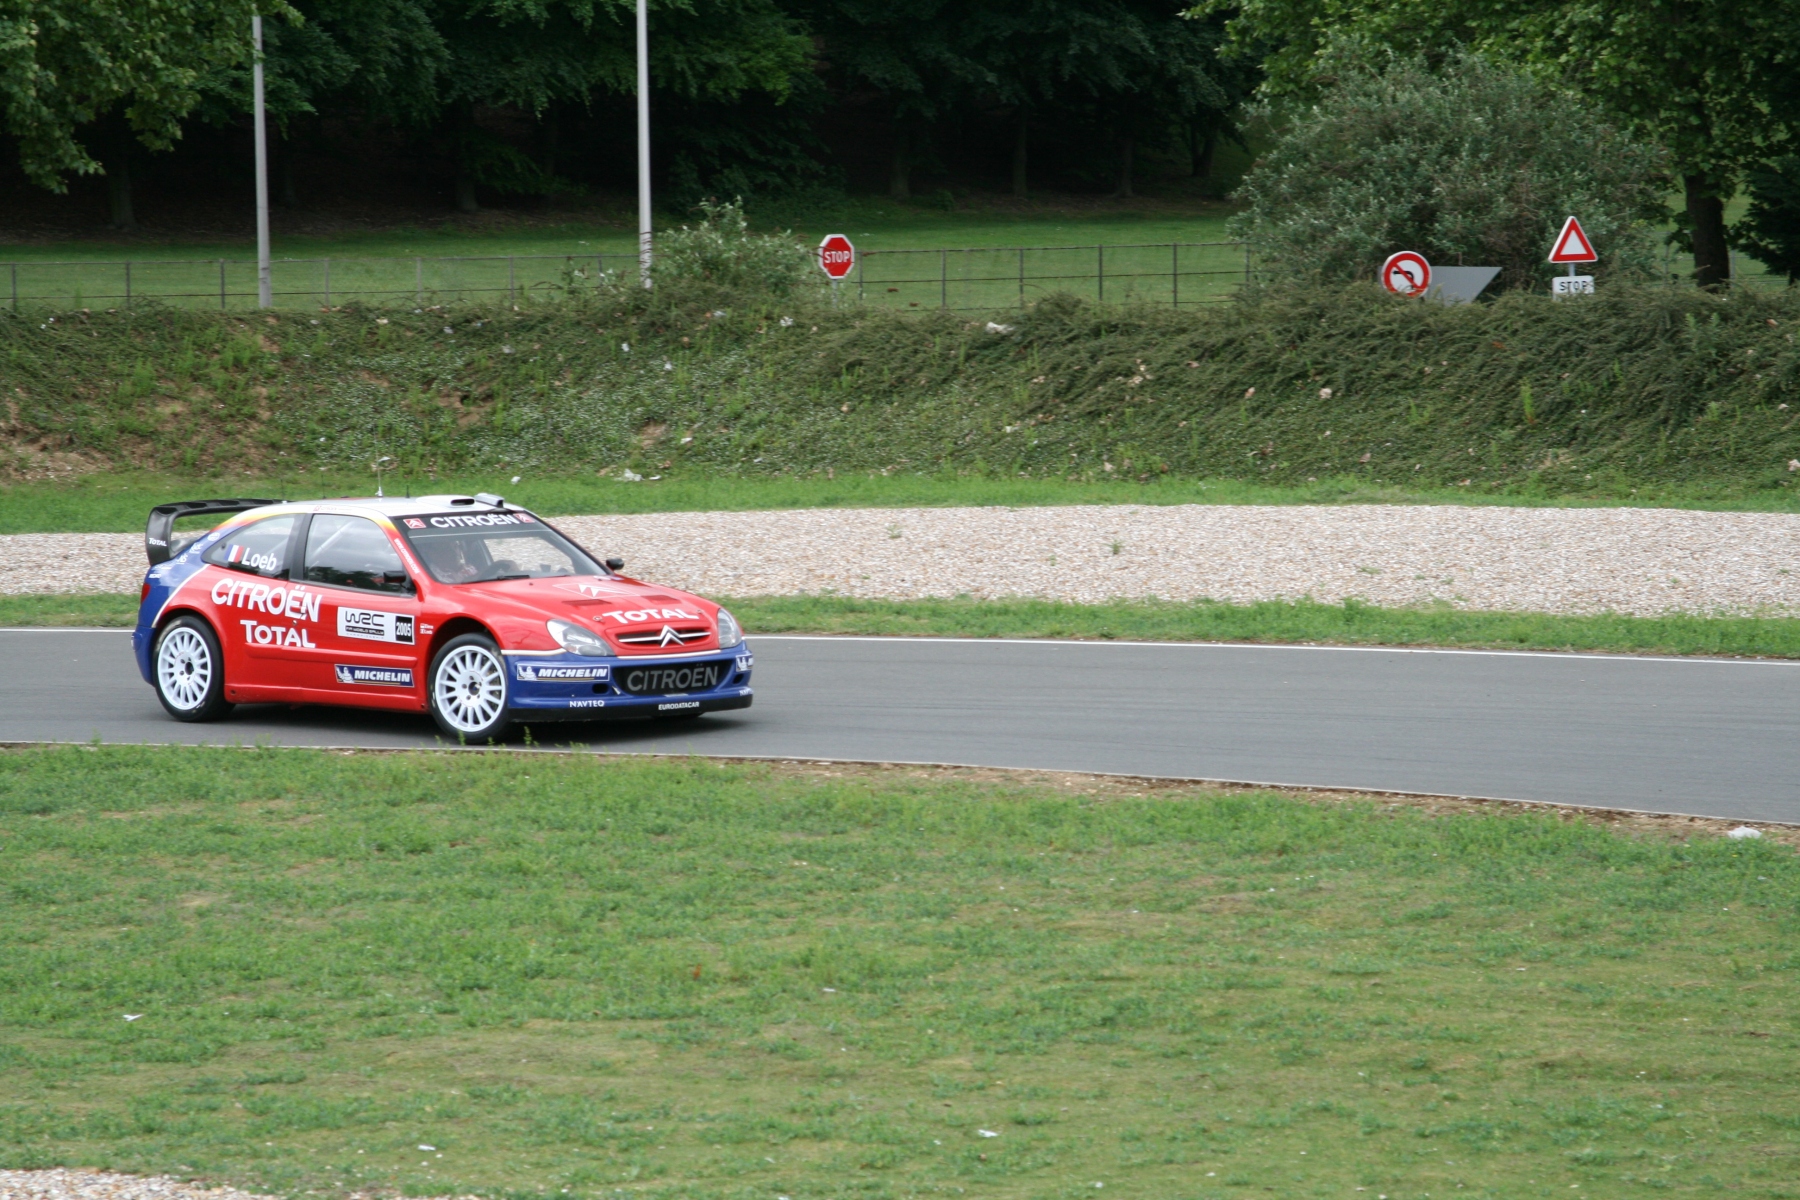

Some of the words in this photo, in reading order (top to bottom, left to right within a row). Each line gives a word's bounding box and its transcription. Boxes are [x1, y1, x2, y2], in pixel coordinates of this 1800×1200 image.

[824, 250, 851, 264] STOP
[1559, 280, 1588, 292] STOP
[430, 513, 520, 528] CITROËN
[148, 537, 168, 547] TOTAL
[241, 547, 278, 571] Loeb
[211, 578, 323, 623] CITROËN
[345, 610, 385, 627] WRC
[602, 608, 700, 624] TOTAL
[239, 619, 316, 649] TOTAL
[396, 621, 412, 637] 2005
[353, 669, 411, 683] MICHELIN
[538, 668, 608, 678] MICHELIN
[627, 663, 719, 692] CITROËN
[658, 701, 700, 711] EURODATACAR
